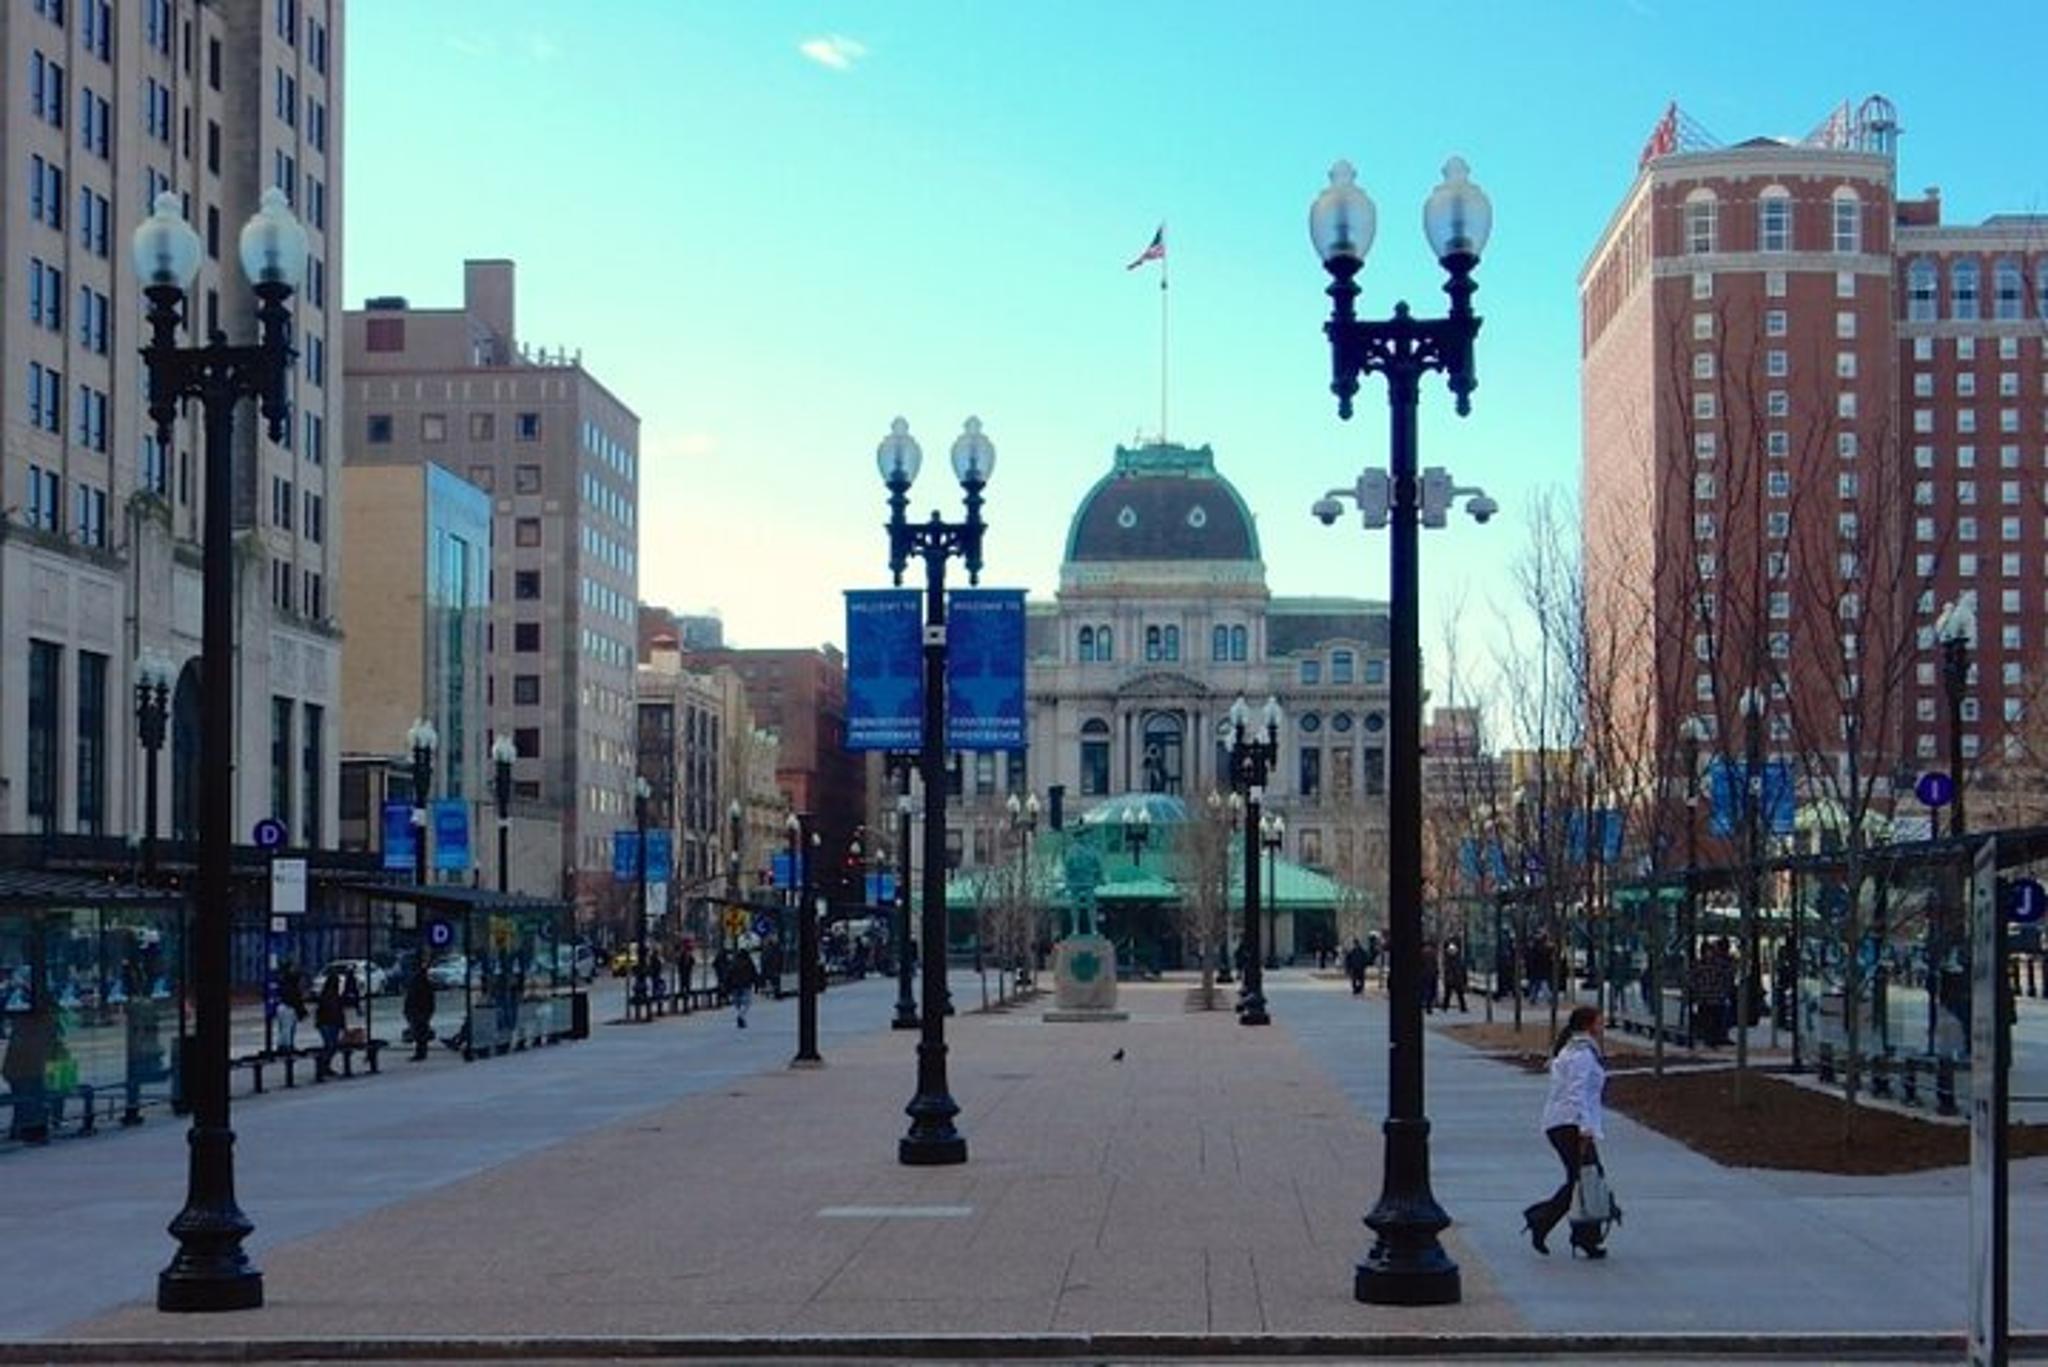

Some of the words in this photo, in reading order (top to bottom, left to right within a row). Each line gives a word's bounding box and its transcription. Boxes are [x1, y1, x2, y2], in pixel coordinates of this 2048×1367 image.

[261, 825, 279, 844] D
[2016, 886, 2032, 916] J
[432, 924, 449, 944] D
